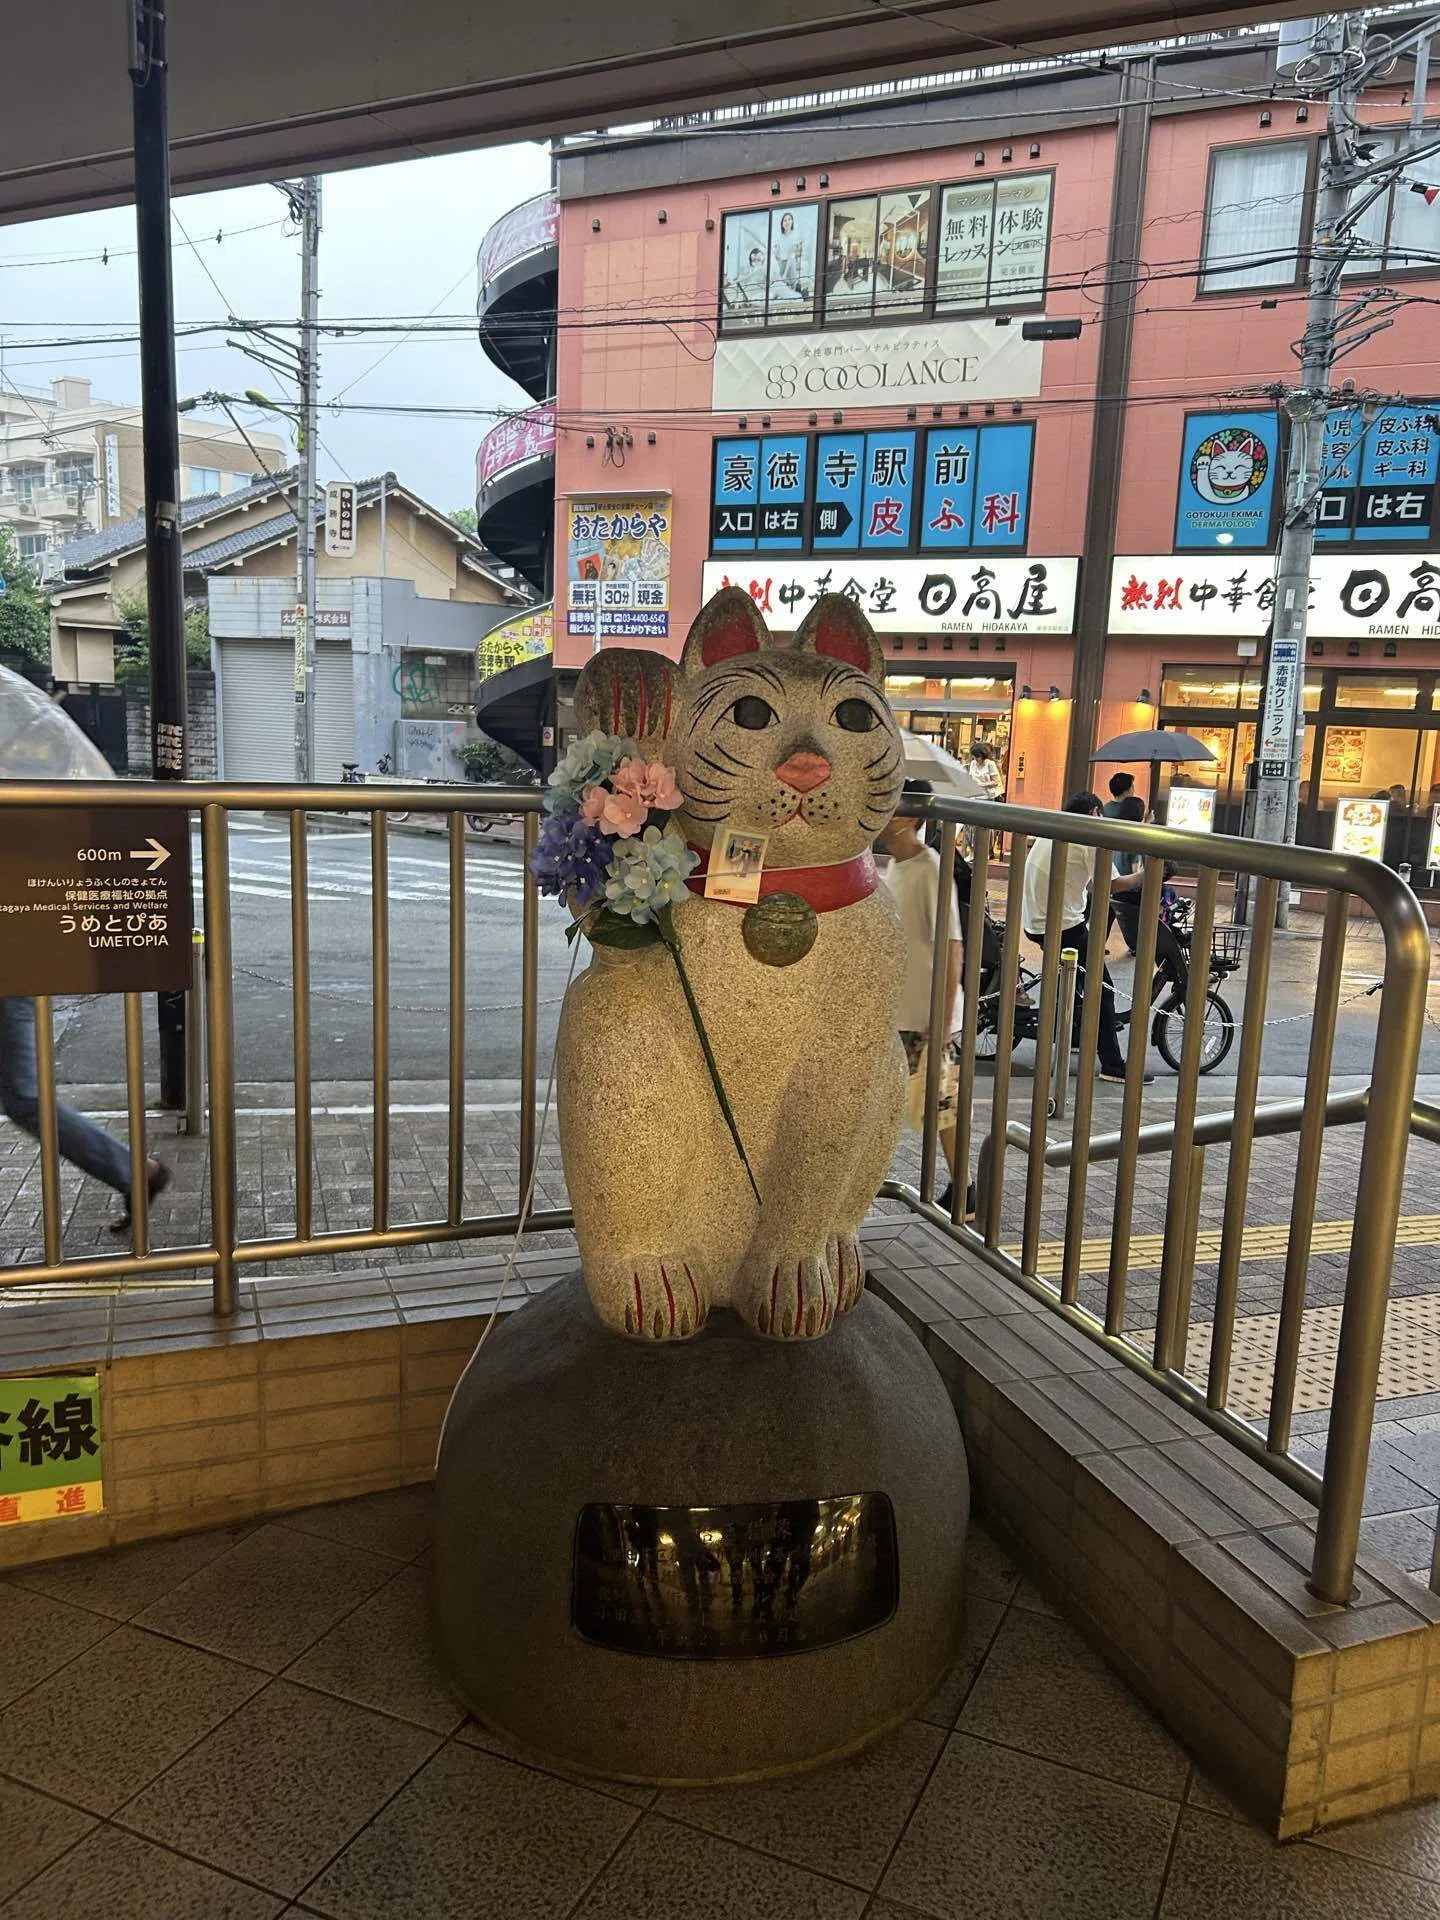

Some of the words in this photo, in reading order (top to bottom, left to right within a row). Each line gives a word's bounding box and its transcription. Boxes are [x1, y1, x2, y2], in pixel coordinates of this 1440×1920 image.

[945, 207, 1044, 241] 無料体験
[944, 240, 1011, 263] レッスン
[803, 340, 941, 358] 女性専門パーソナルピラティス
[805, 356, 979, 393] COCOLANCE
[723, 445, 970, 492] 豪徳寺駅前
[719, 509, 837, 532] 入口は右側
[868, 493, 1020, 537] 皮ふ科
[1185, 511, 1229, 519] GOTOKUJI
[1231, 510, 1263, 518] EKIMAE
[572, 513, 667, 539] おたからや
[1191, 519, 1256, 528] DERMATOLOGY
[573, 590, 597, 604] 無料
[604, 590, 630, 604] 30分
[637, 590, 664, 604] 現金
[919, 563, 1057, 619] 日高屋
[622, 613, 666, 624] 03-4400-6542
[941, 622, 973, 632] RAMEN
[982, 622, 1028, 632] HIDAKAYA
[1369, 624, 1409, 635] RAMEN
[1272, 665, 1289, 736] 赤堤クリニック
[77, 849, 122, 861] 600m
[27, 877, 168, 887] ほけんいりょうふくしのきょてん
[65, 890, 168, 901] 保健医療福祉の拠点
[33, 903, 70, 911] Medical
[73, 901, 110, 911] Services
[113, 902, 130, 910] and
[133, 901, 168, 910] Welfare
[60, 913, 168, 933] うめとぴあ
[88, 935, 169, 948] UMETOPIA
[0, 1393, 99, 1470] 線
